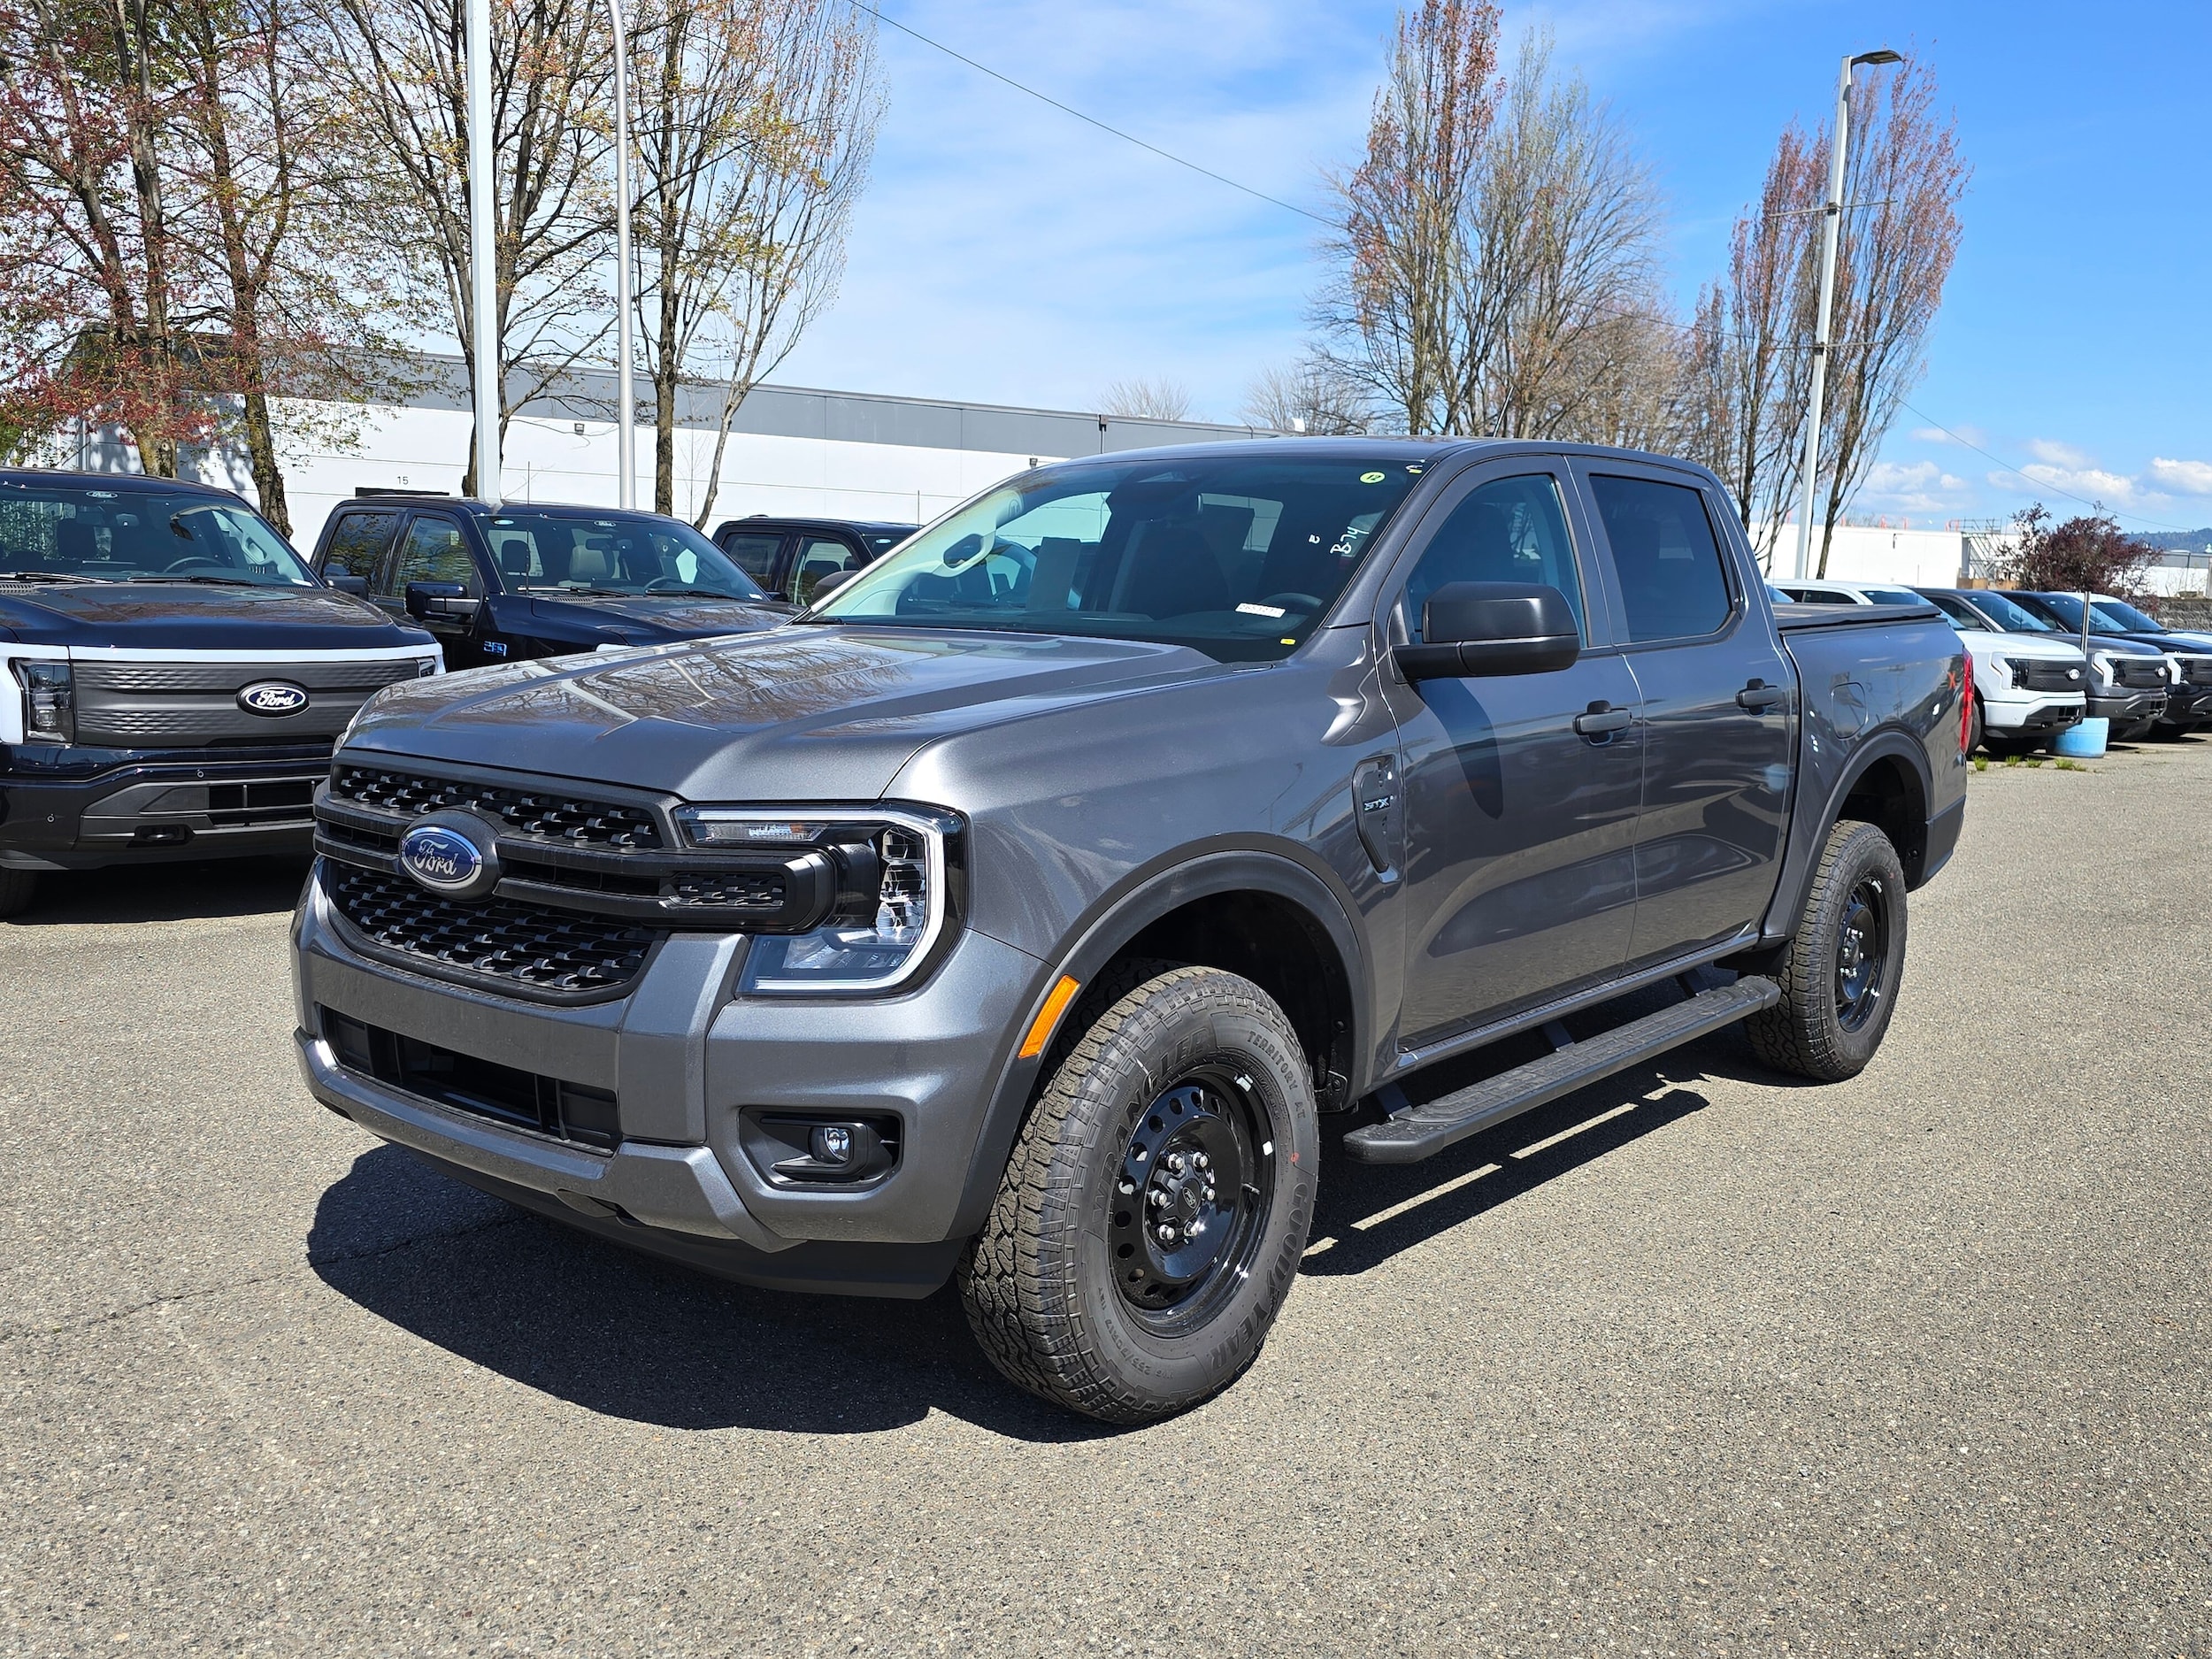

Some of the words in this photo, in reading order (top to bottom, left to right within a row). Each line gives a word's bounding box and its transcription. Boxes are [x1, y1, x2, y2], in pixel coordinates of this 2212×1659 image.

[396, 476, 409, 486] 15
[257, 690, 295, 706] Ford
[414, 839, 458, 876] Ford
[1247, 1031, 1299, 1091] TERRITORY
[1294, 1101, 1306, 1119] AT
[1092, 1027, 1209, 1224] WRANGLER
[1210, 1182, 1309, 1369] GOODYEAR
